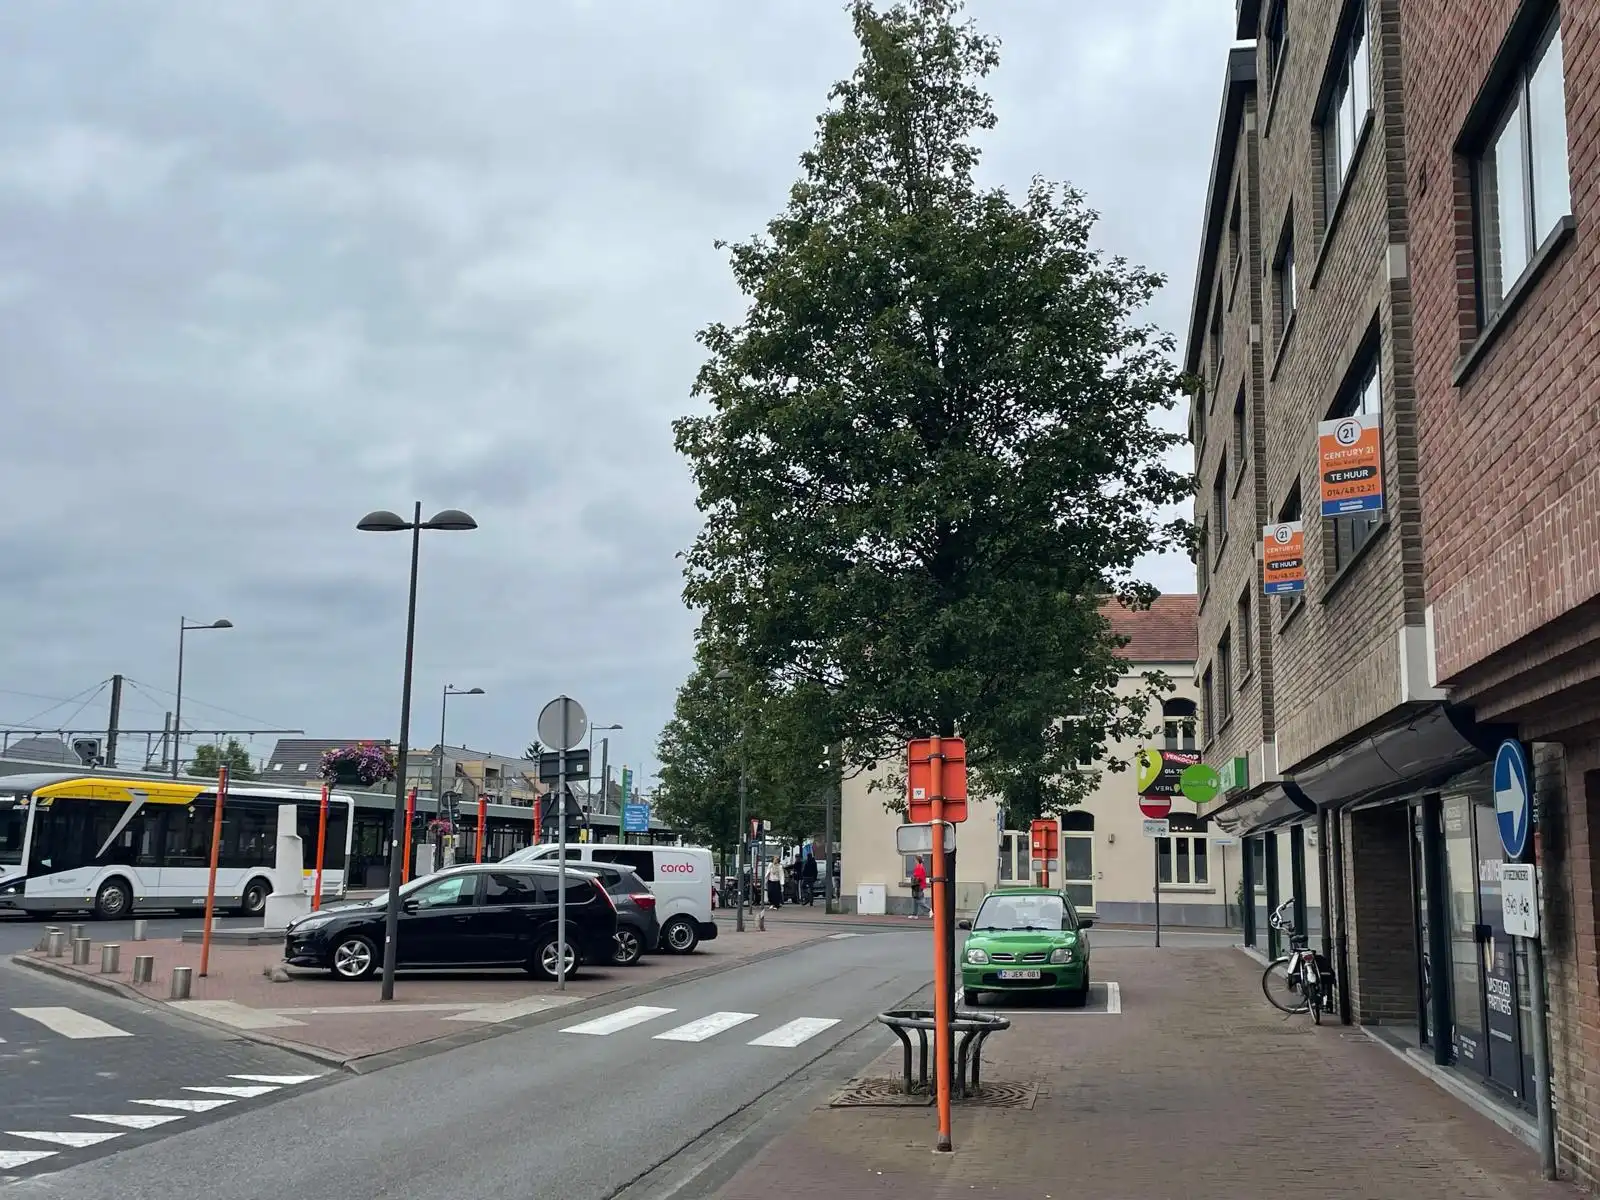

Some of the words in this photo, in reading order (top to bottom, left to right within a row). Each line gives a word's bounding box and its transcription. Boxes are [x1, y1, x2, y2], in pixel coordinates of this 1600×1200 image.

[1323, 447, 1364, 460] CENTURY
[1365, 446, 1374, 454] 21
[1331, 473, 1342, 481] TE
[1343, 469, 1369, 480] HUUR
[660, 861, 694, 873] corob
